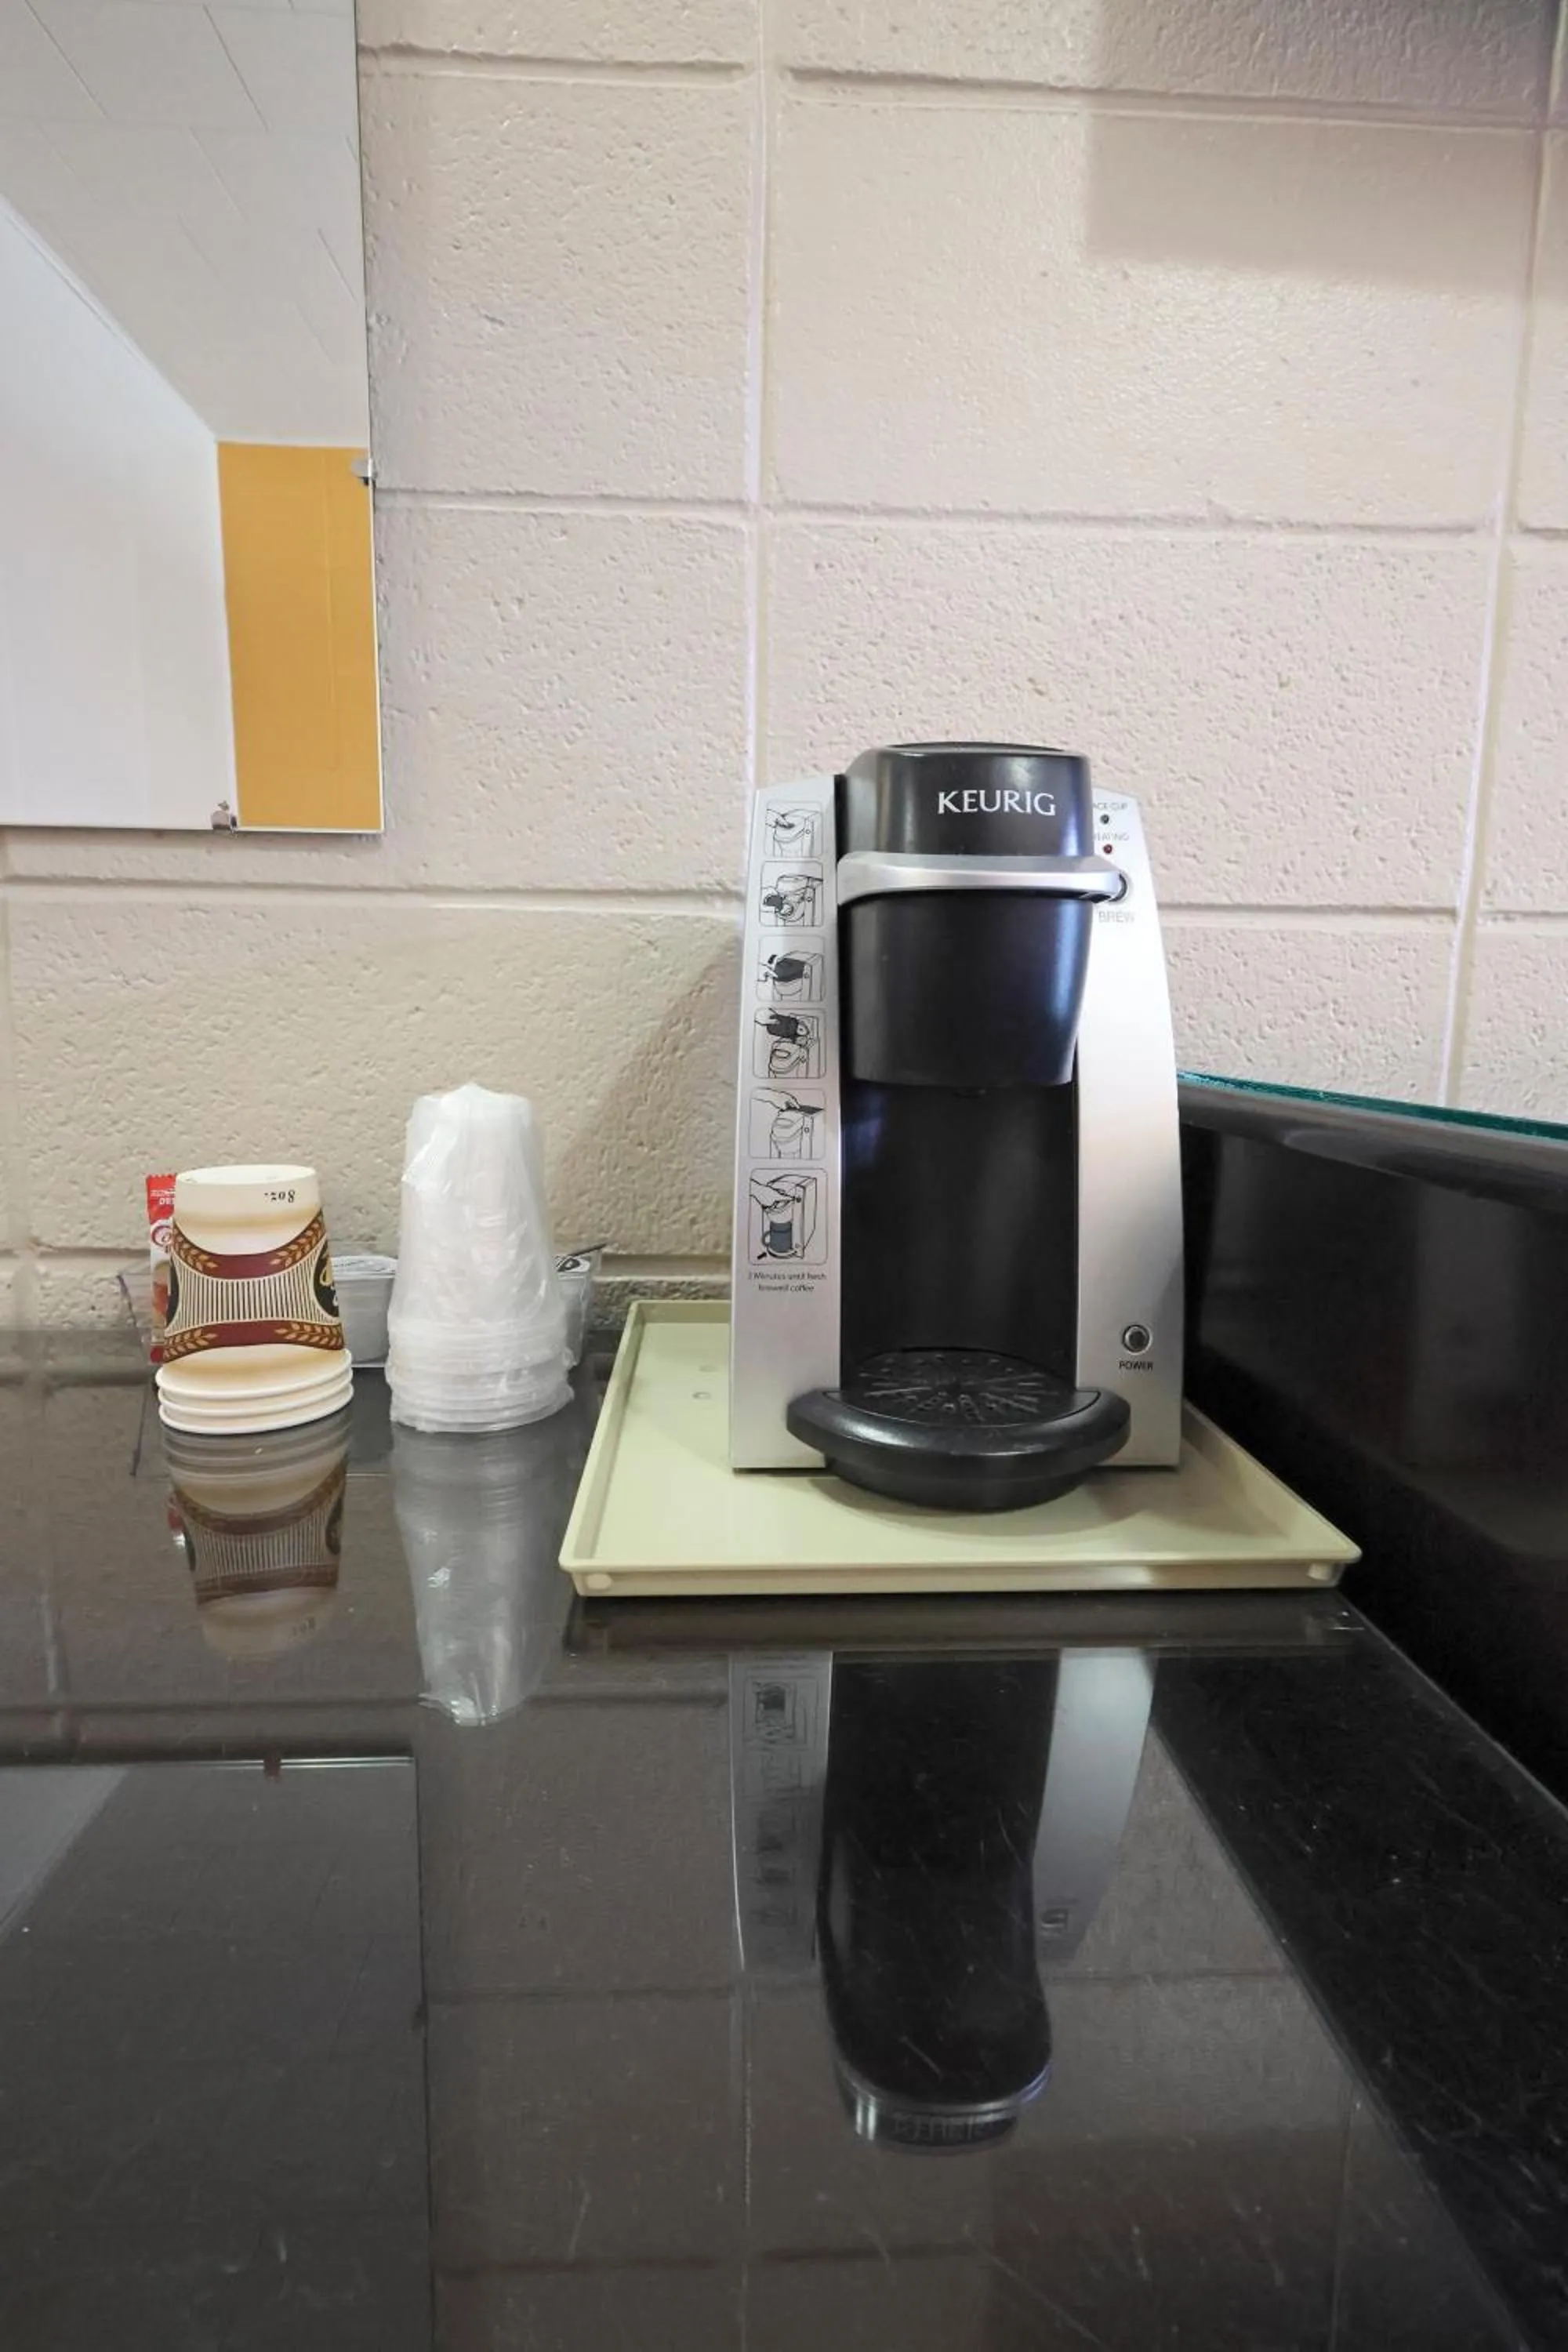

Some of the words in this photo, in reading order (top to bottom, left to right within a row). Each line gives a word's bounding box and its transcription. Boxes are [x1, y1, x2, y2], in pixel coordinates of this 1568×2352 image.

[938, 789, 1056, 815] KEURIG
[1094, 833, 1130, 841] EATING
[1098, 910, 1135, 923] BREW
[790, 1284, 815, 1293] coffee
[1119, 1360, 1153, 1371] POWER
